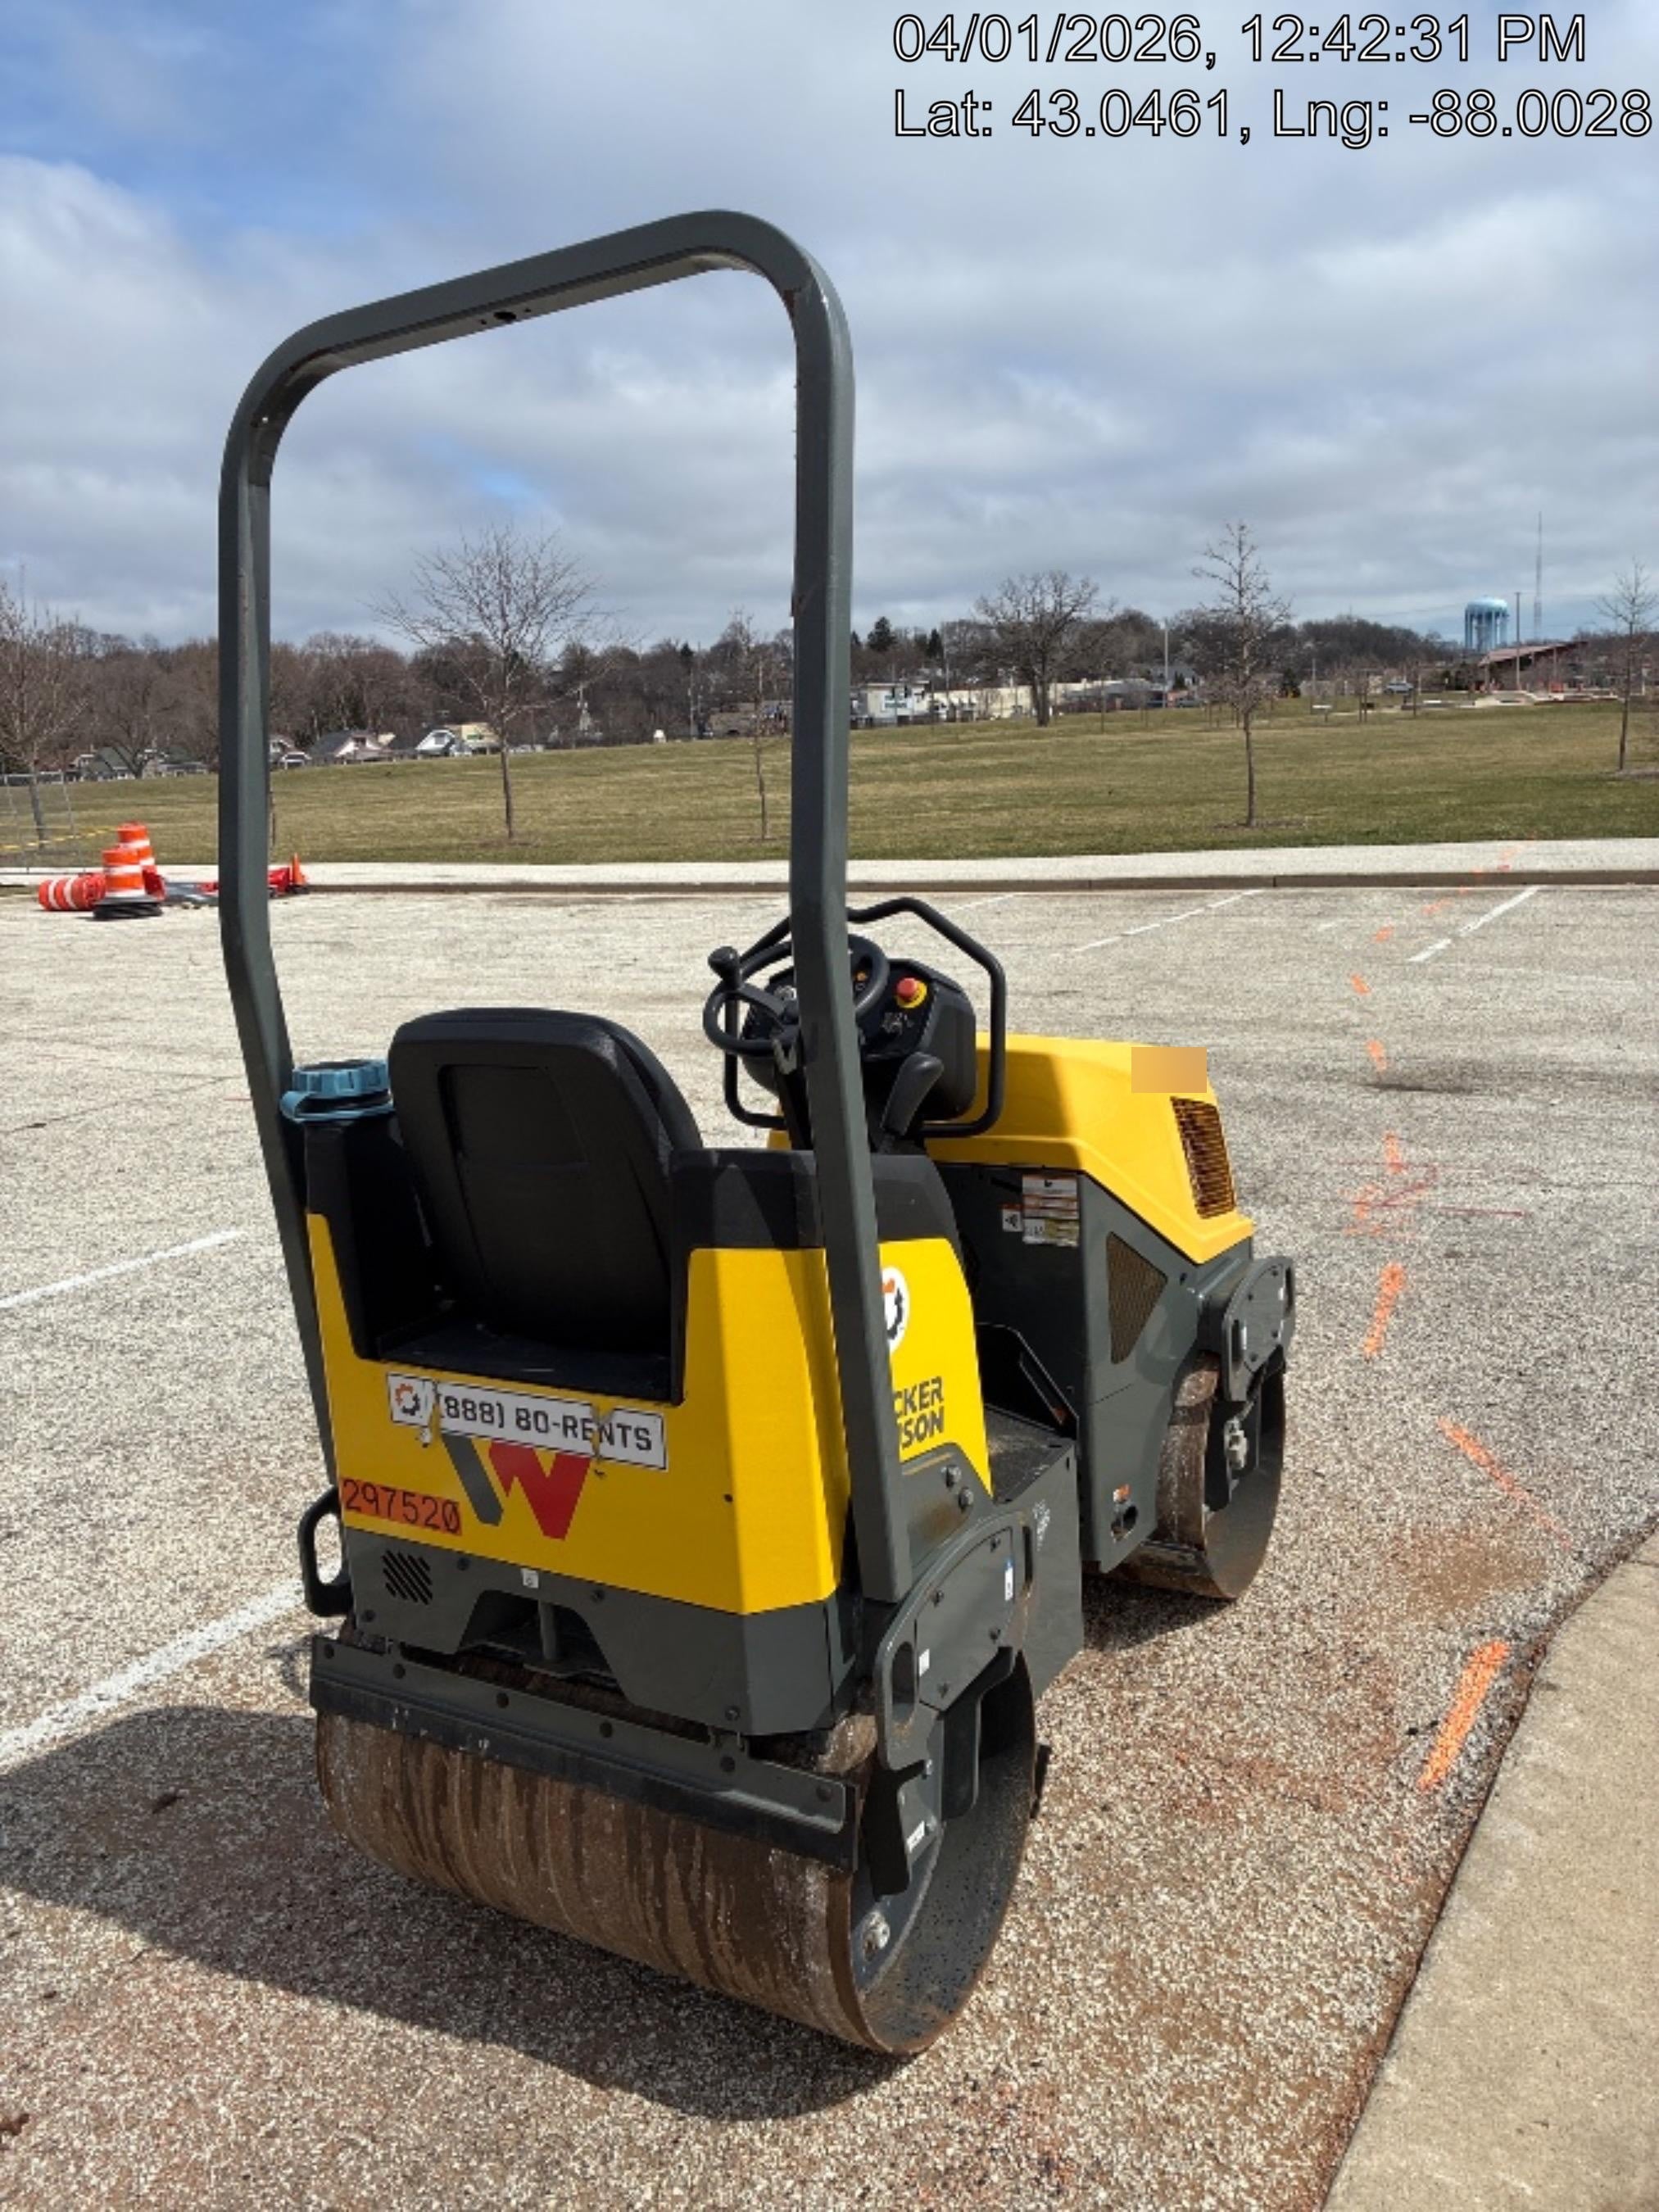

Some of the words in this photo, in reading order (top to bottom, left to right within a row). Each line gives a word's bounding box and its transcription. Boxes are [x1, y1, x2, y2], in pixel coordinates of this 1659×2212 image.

[435, 1393, 505, 1429] (888)
[515, 1407, 652, 1451] 80-RENTS
[343, 1479, 460, 1534] 297520
